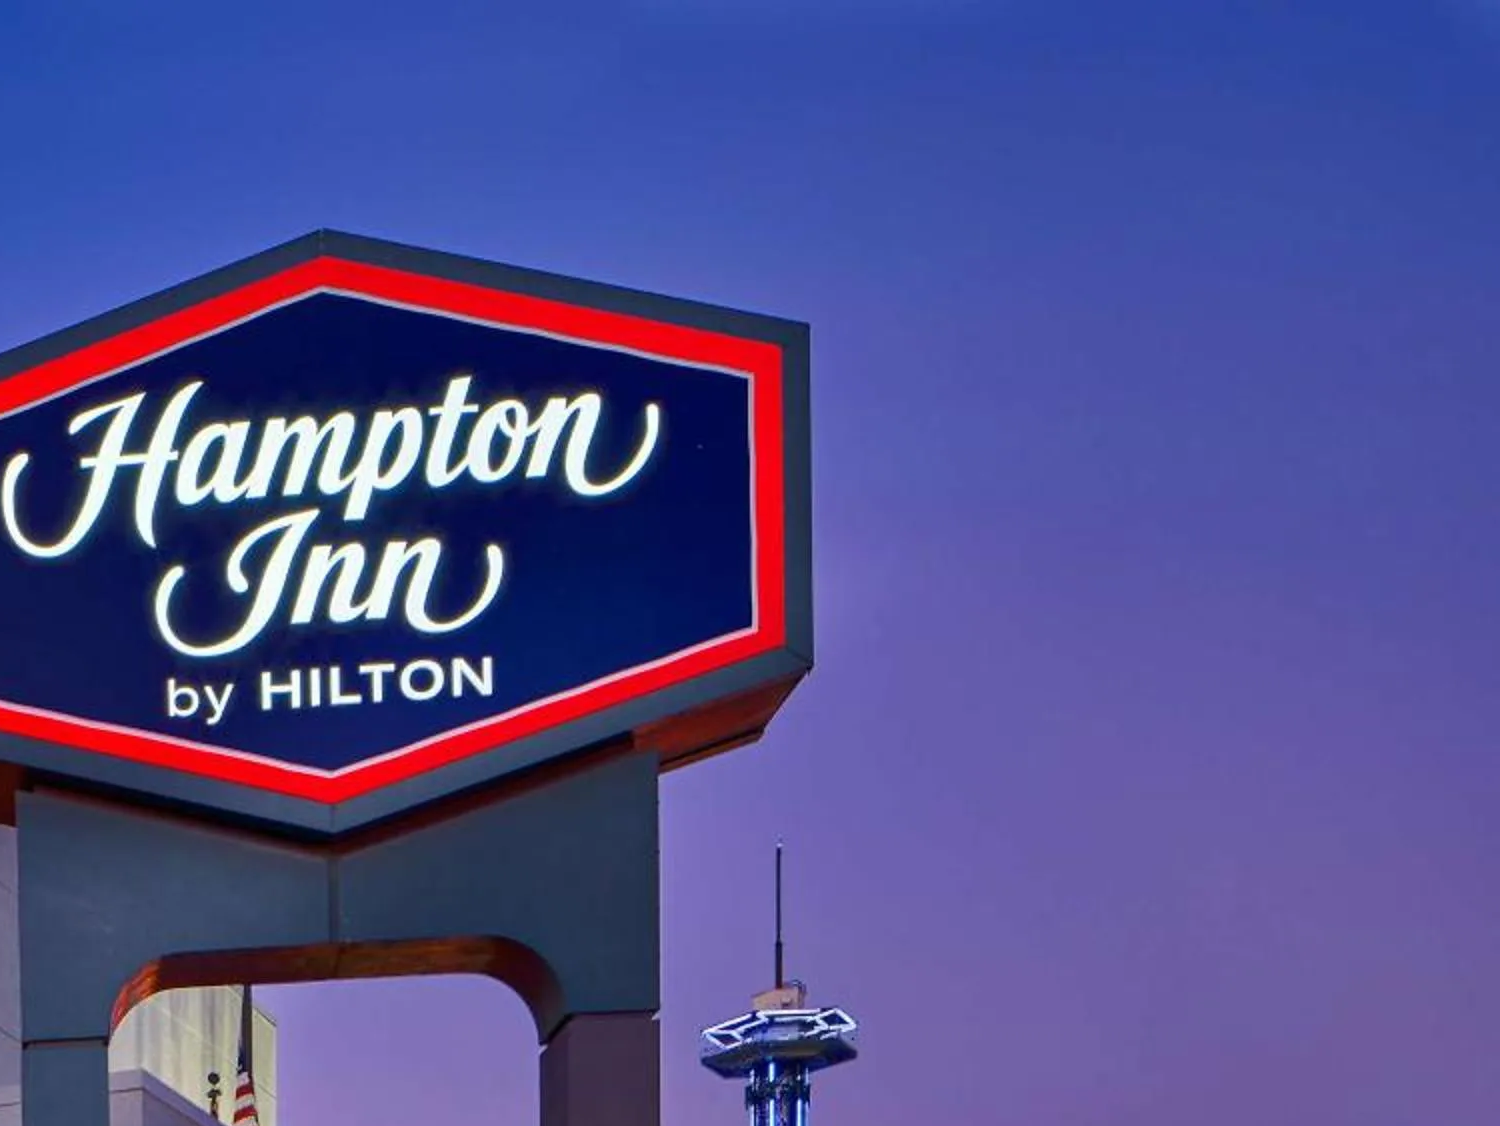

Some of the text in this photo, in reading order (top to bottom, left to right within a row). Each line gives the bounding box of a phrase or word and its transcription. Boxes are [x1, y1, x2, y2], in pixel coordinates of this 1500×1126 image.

[2, 375, 660, 560] Hampton
[155, 509, 504, 658] Inn
[167, 656, 493, 725] by HILTON
